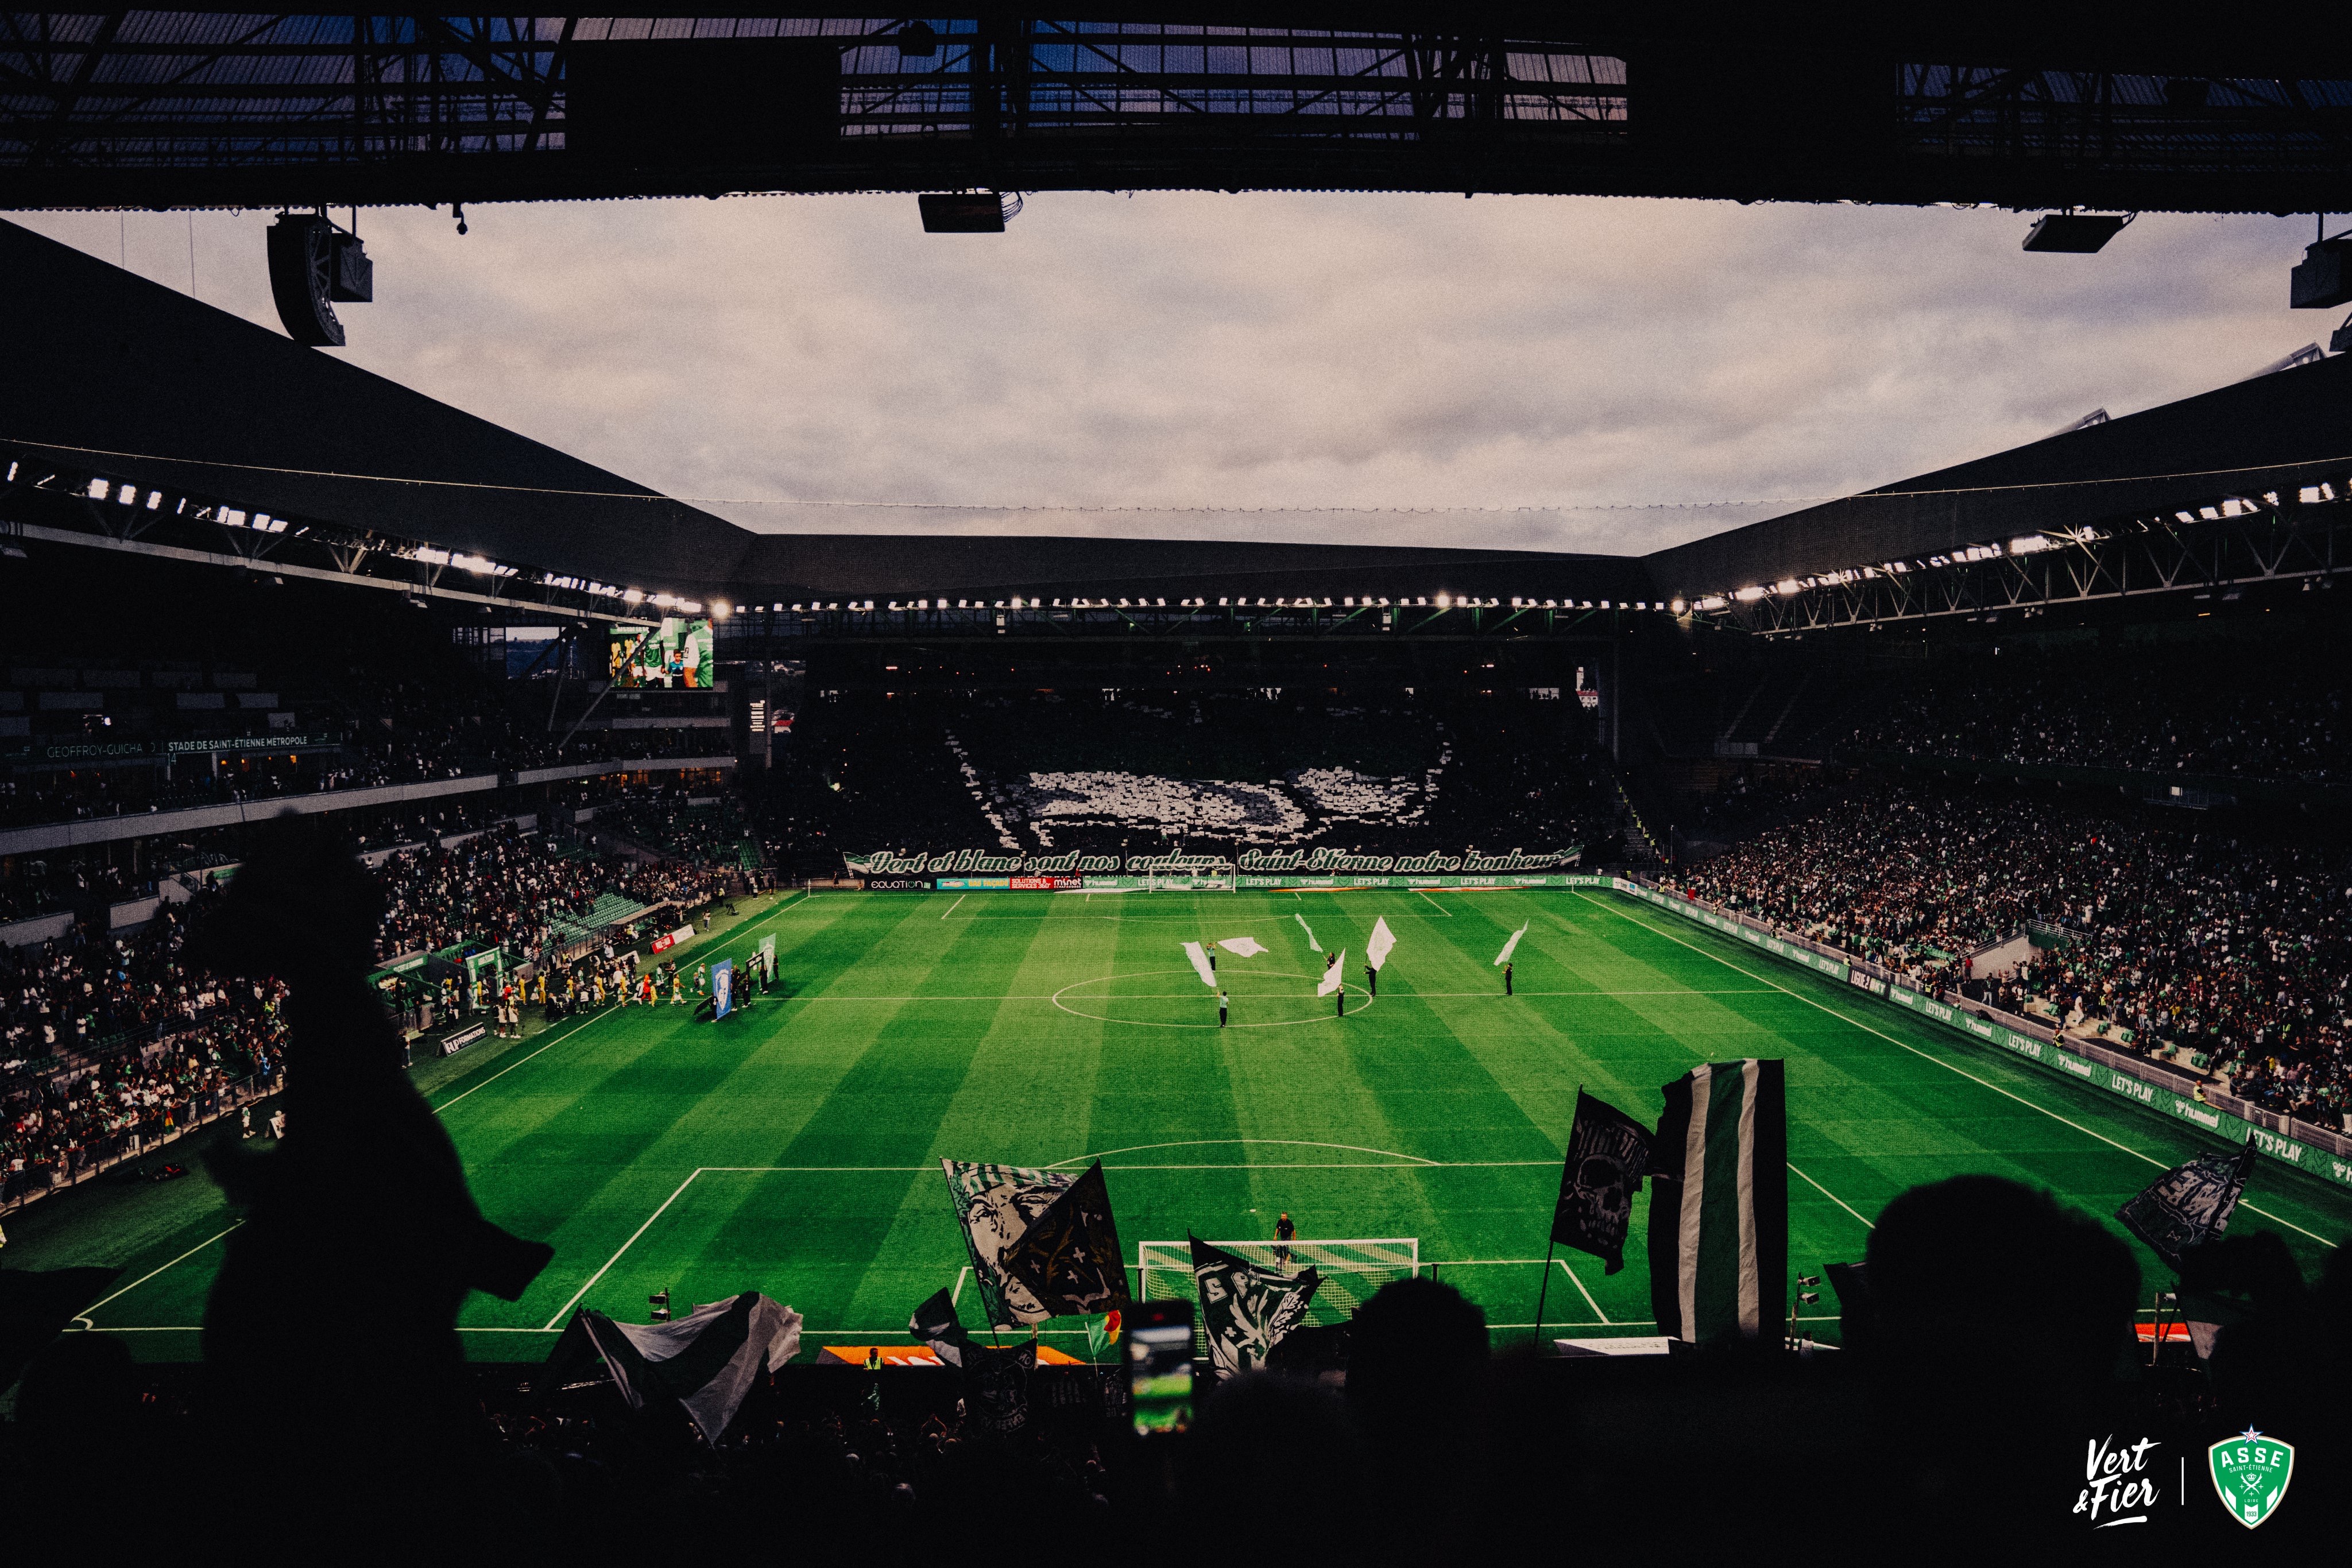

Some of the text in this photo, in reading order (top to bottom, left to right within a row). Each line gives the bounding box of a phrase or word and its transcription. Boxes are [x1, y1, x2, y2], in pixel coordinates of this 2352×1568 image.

[168, 740, 195, 752] STADE
[197, 740, 207, 750] DE
[209, 737, 265, 749] SAINT-ÉTIENNE
[266, 735, 307, 746] MÉTROPOLE
[871, 851, 928, 873] Vert
[928, 850, 956, 872] et
[953, 849, 1022, 872] blanc
[1024, 849, 1080, 872] sont
[1078, 855, 1121, 871] nos
[1126, 848, 1231, 871] couleurs
[1393, 850, 1461, 872] notre
[1463, 847, 1561, 871] bonheur
[1054, 878, 1081, 886] minet
[1851, 970, 1866, 988] LIGUE
[1864, 975, 1870, 990] 2
[1925, 1001, 1952, 1021] LET'S PLAY
[458, 1027, 486, 1044] FORMATIONS
[2009, 1033, 2041, 1058] LET'S PLAY
[2065, 1057, 2091, 1077] hummel
[2112, 1074, 2153, 1102] LET'S PLAY
[2185, 1103, 2219, 1128] hummel
[2275, 1139, 2302, 1162] PLAY
